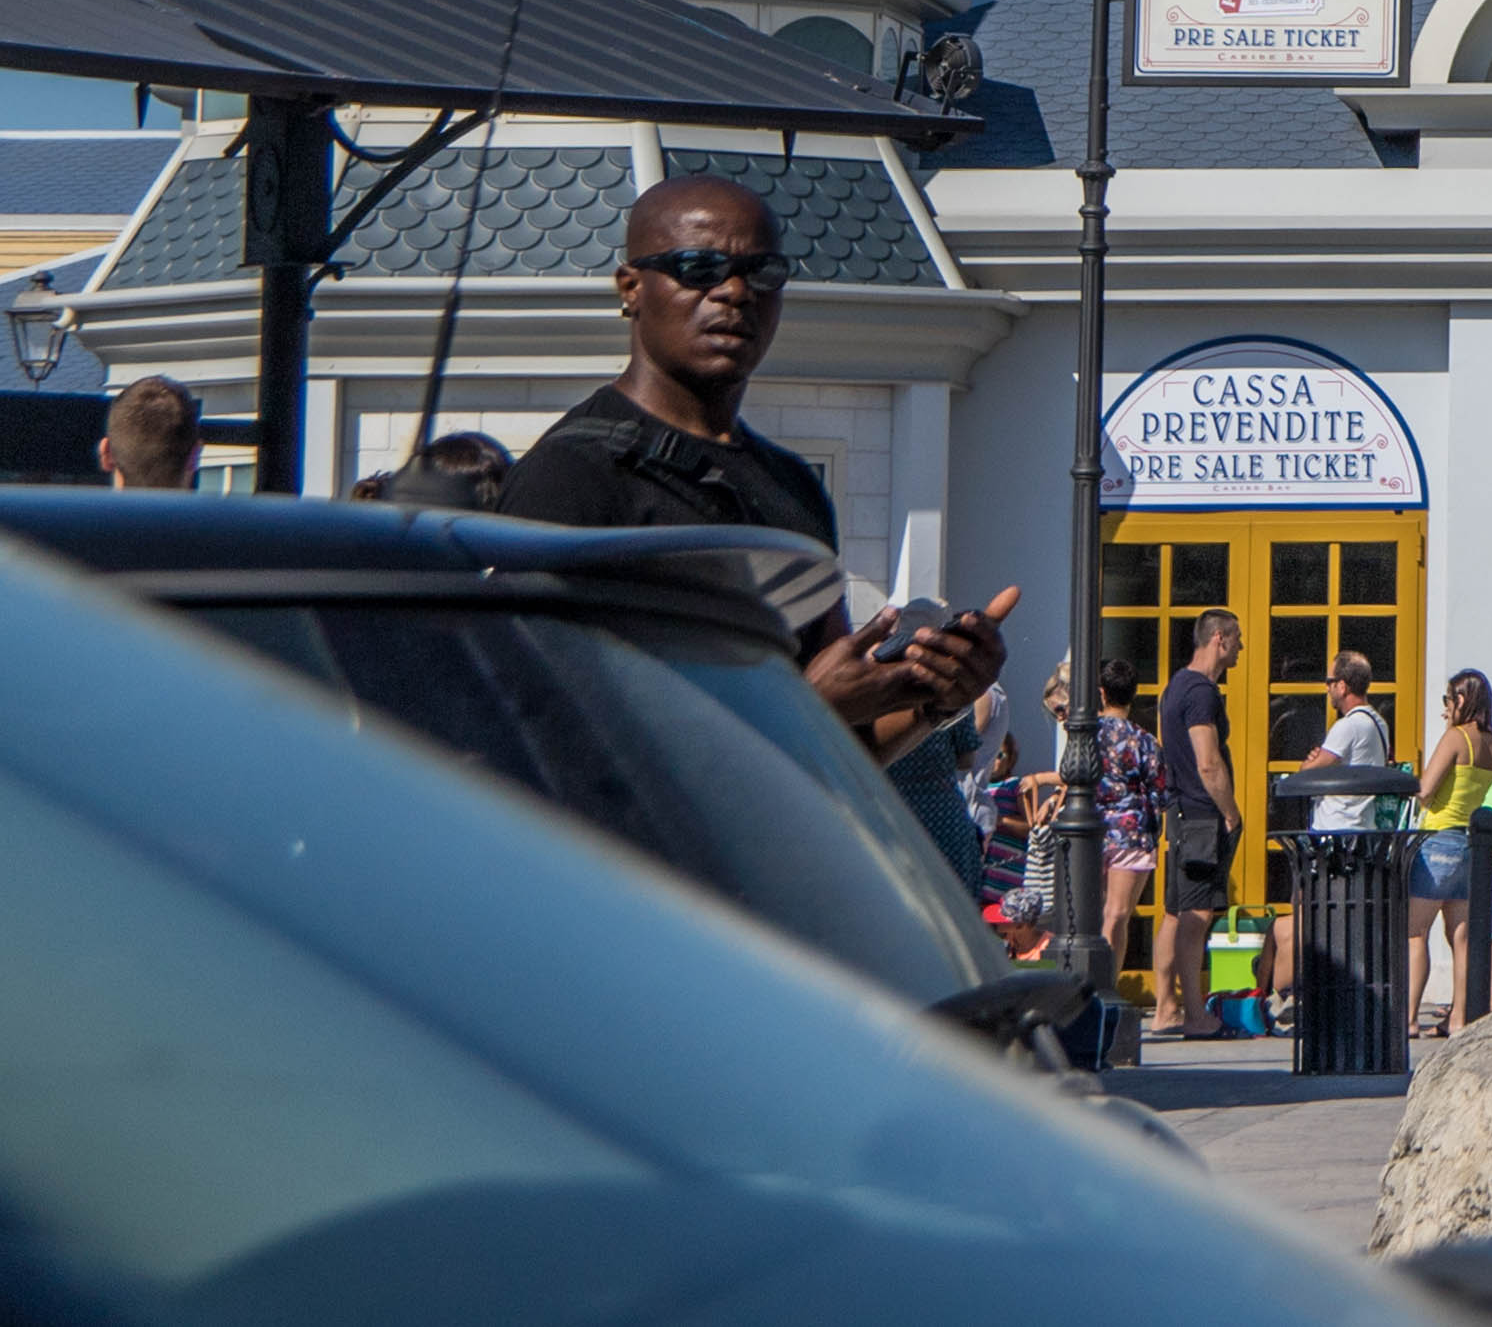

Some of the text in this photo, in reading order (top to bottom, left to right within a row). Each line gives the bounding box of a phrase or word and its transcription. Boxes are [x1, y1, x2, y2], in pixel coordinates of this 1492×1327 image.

[1173, 28, 1361, 48] PRE SALE TICKET
[1192, 374, 1315, 407] CASSA
[1141, 410, 1366, 444] PREVENDITE
[1129, 453, 1378, 481] PRE SALE TICKET
